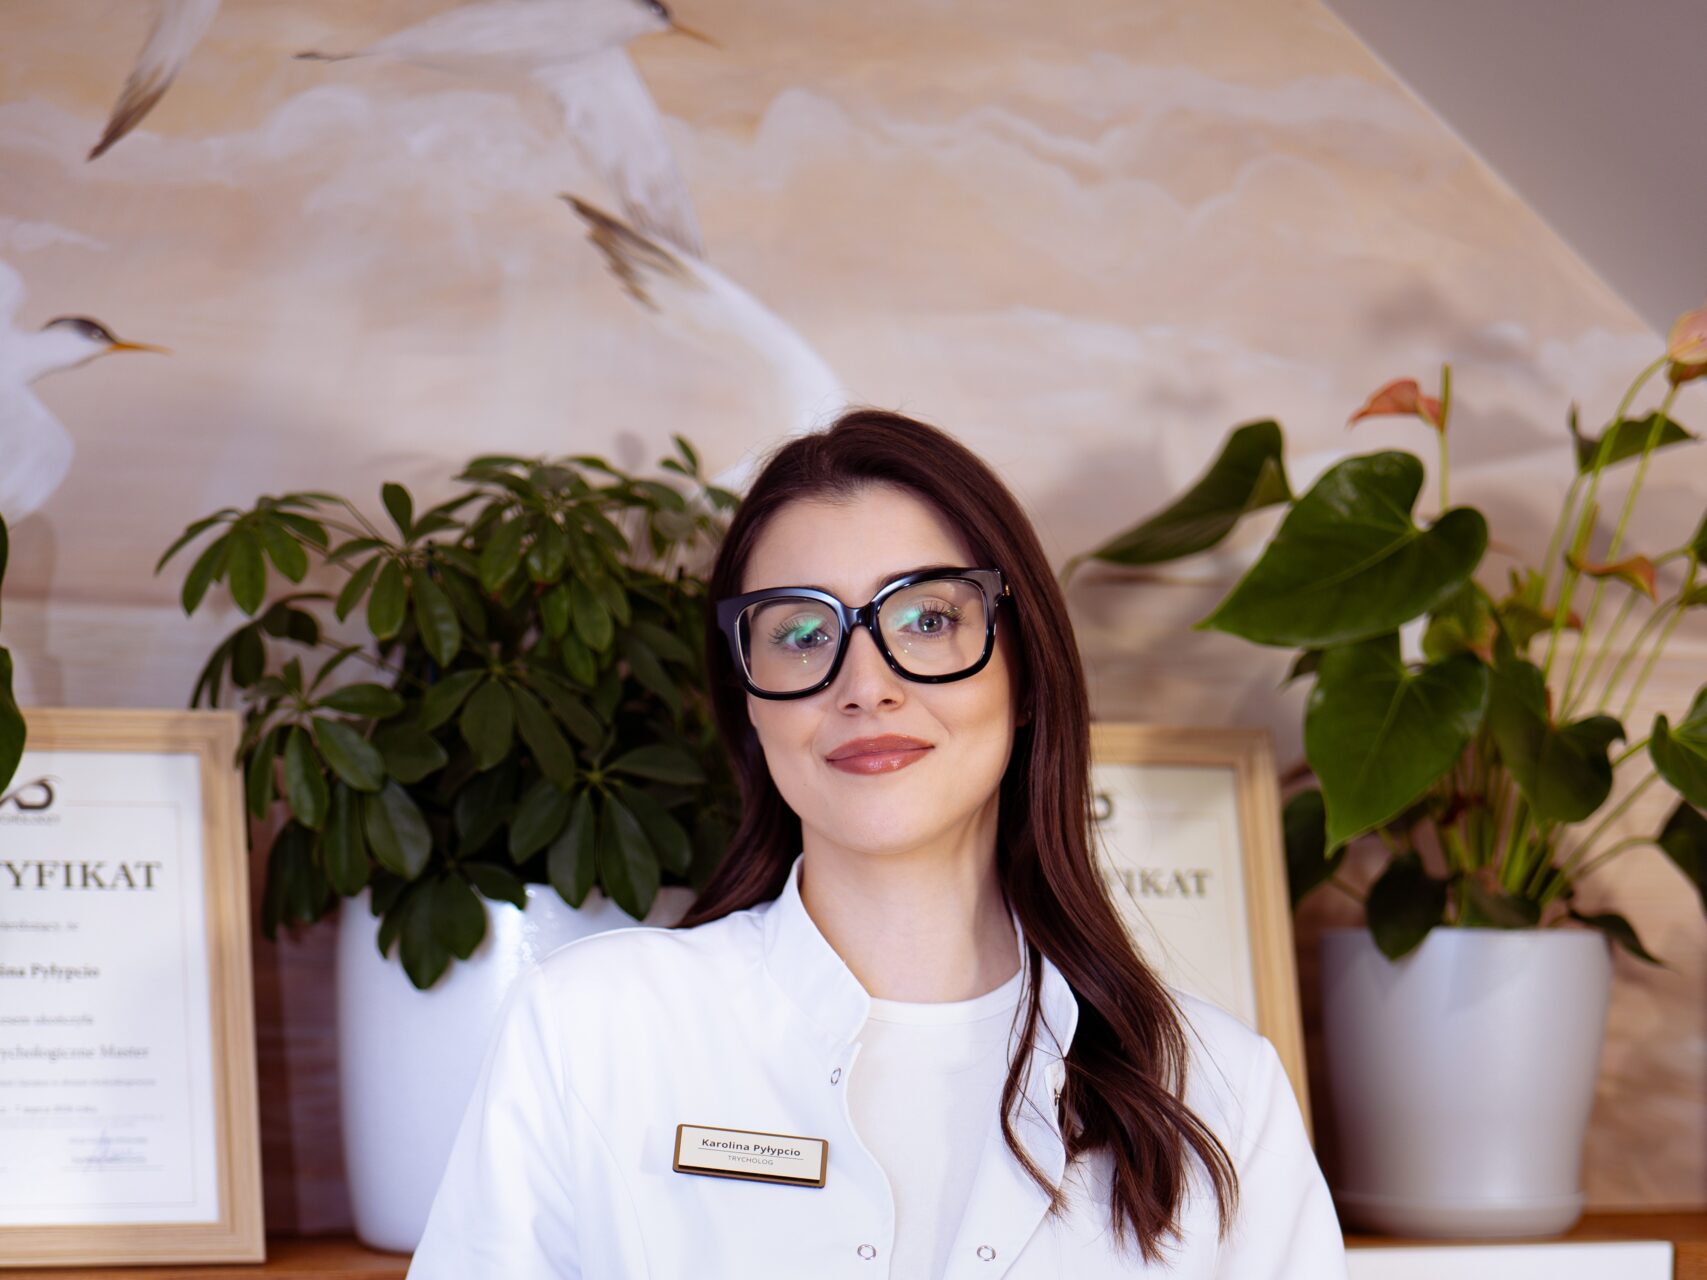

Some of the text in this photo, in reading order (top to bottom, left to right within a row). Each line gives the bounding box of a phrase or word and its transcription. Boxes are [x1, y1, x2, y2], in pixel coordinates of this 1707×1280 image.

[0, 861, 162, 890] YFIKAT
[701, 1138, 801, 1157] Karolina Pyłypcio
[728, 1155, 774, 1166] TRYCHOLOG
